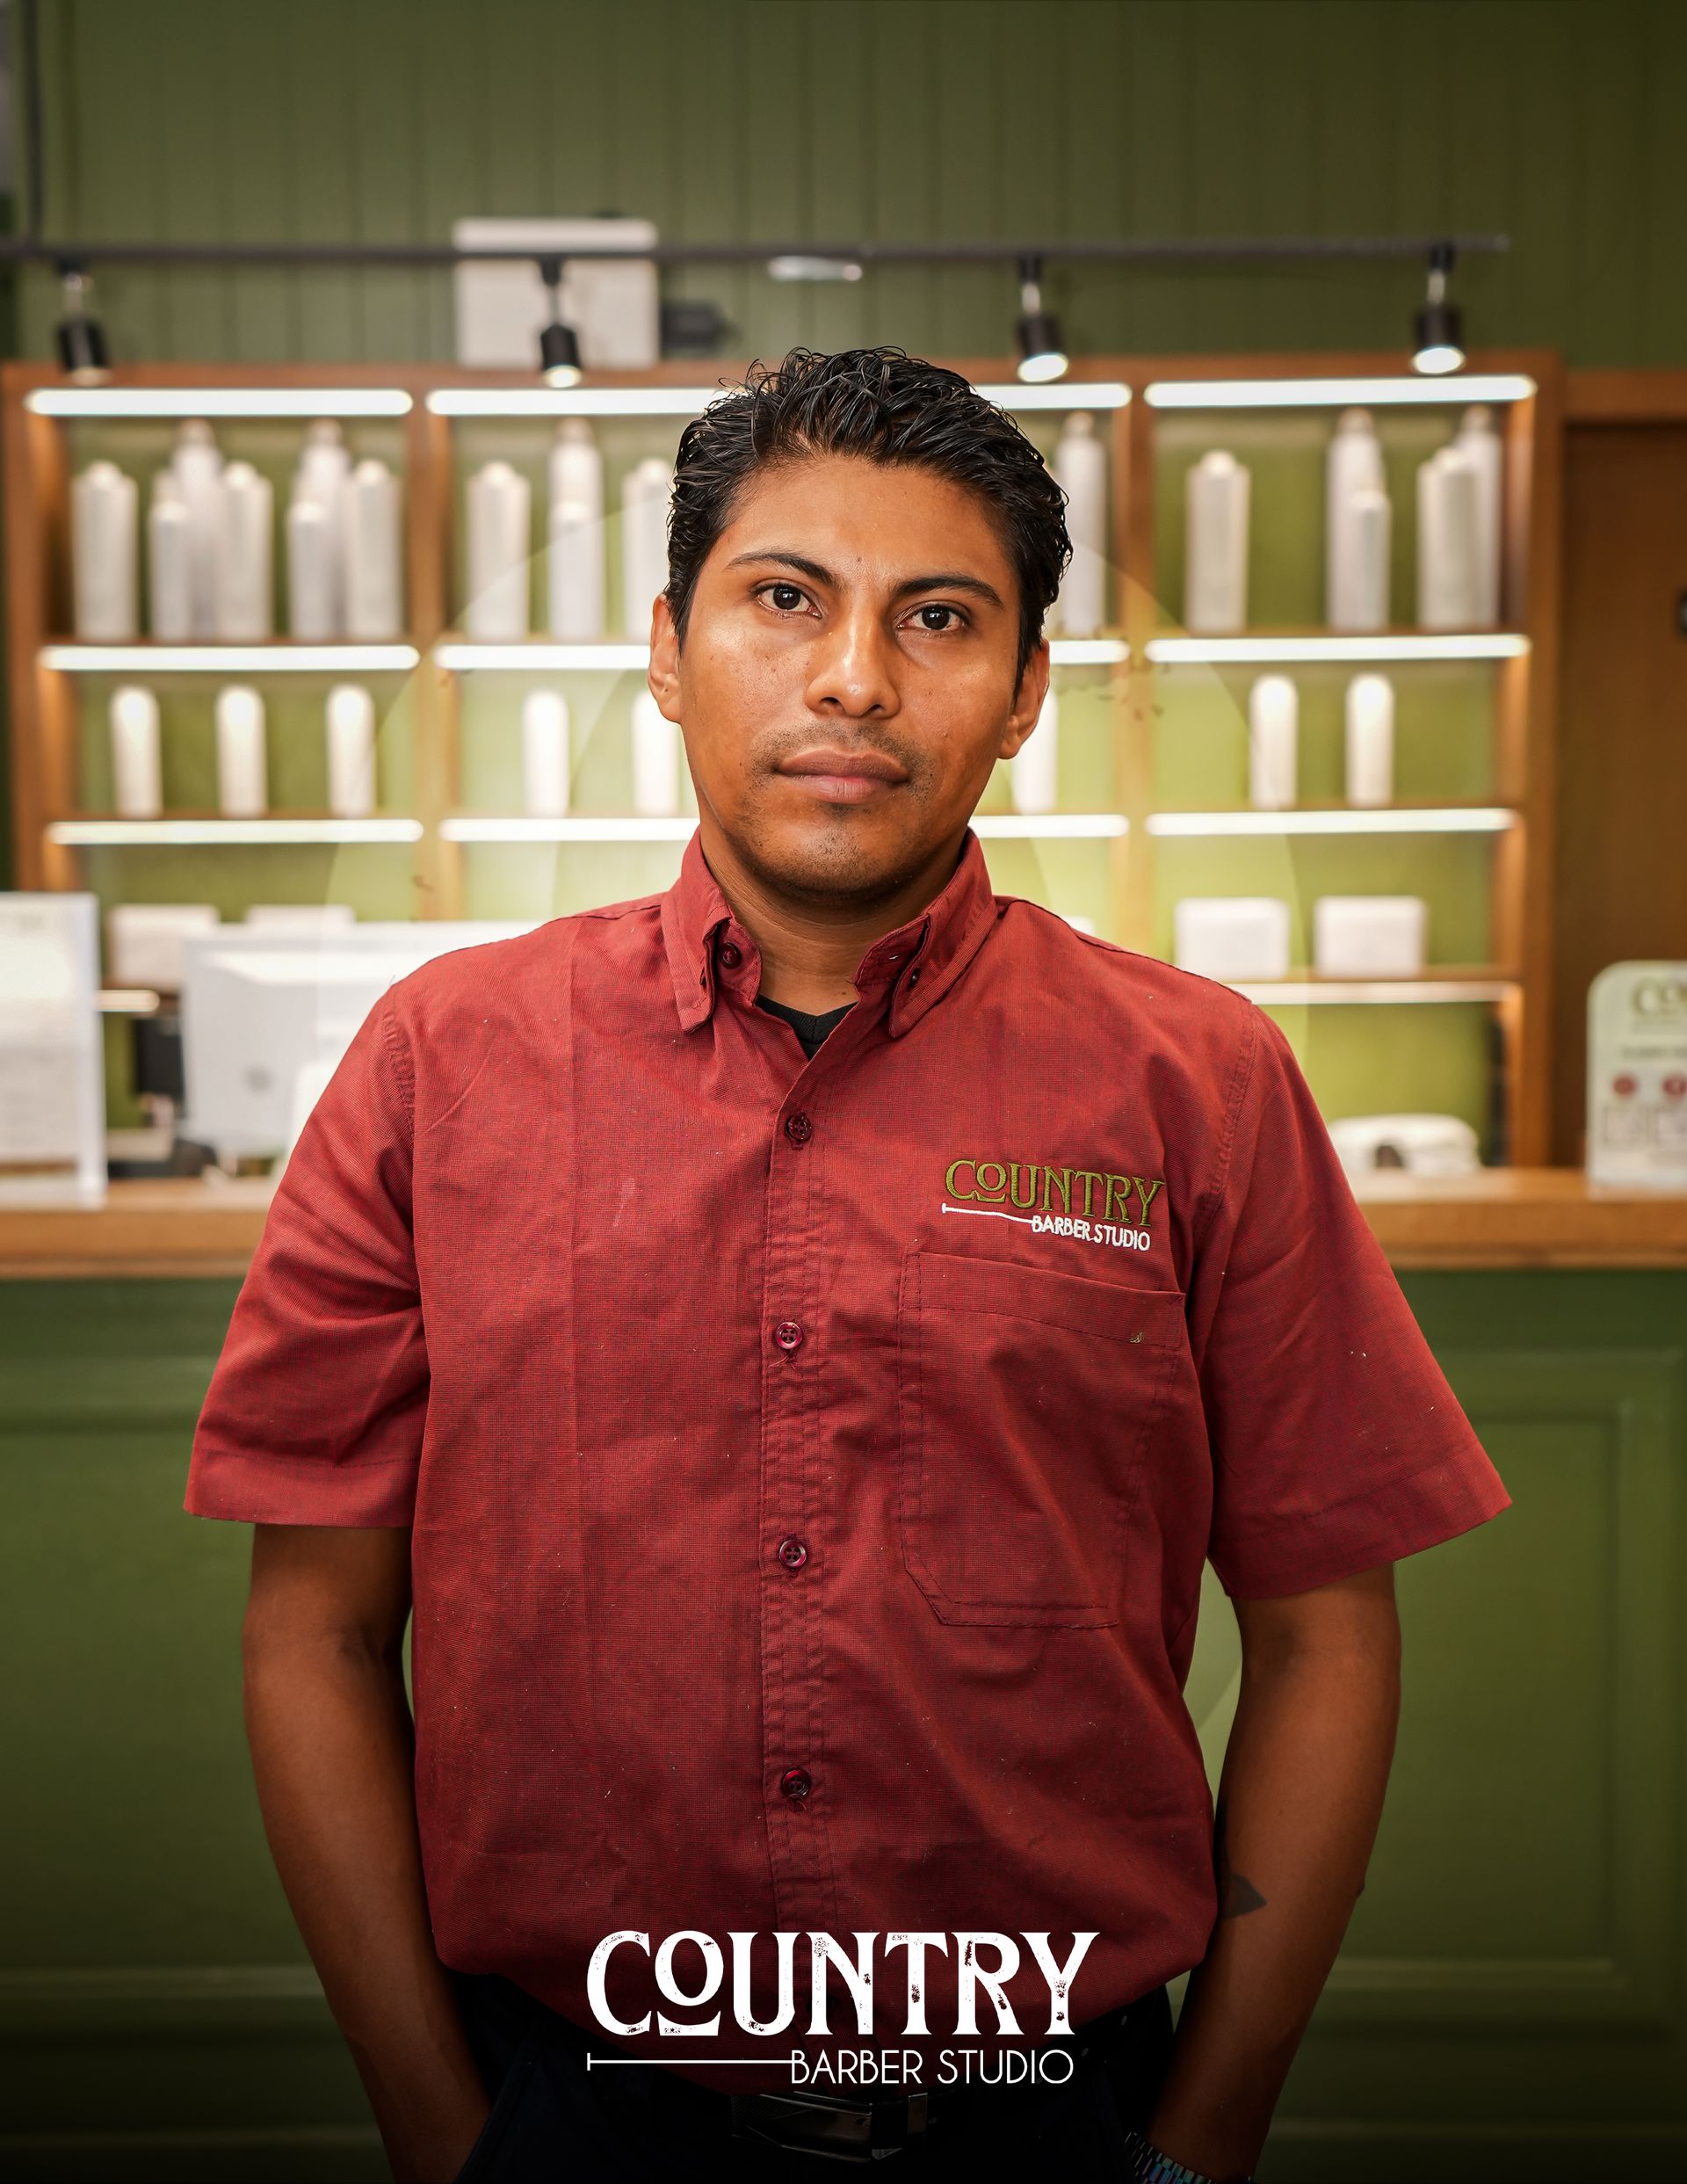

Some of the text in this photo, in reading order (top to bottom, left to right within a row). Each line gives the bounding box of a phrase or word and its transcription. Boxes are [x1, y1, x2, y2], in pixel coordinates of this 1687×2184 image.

[945, 1159, 1165, 1226] COUNTRY
[1032, 1215, 1151, 1252] BARBER STUDIO
